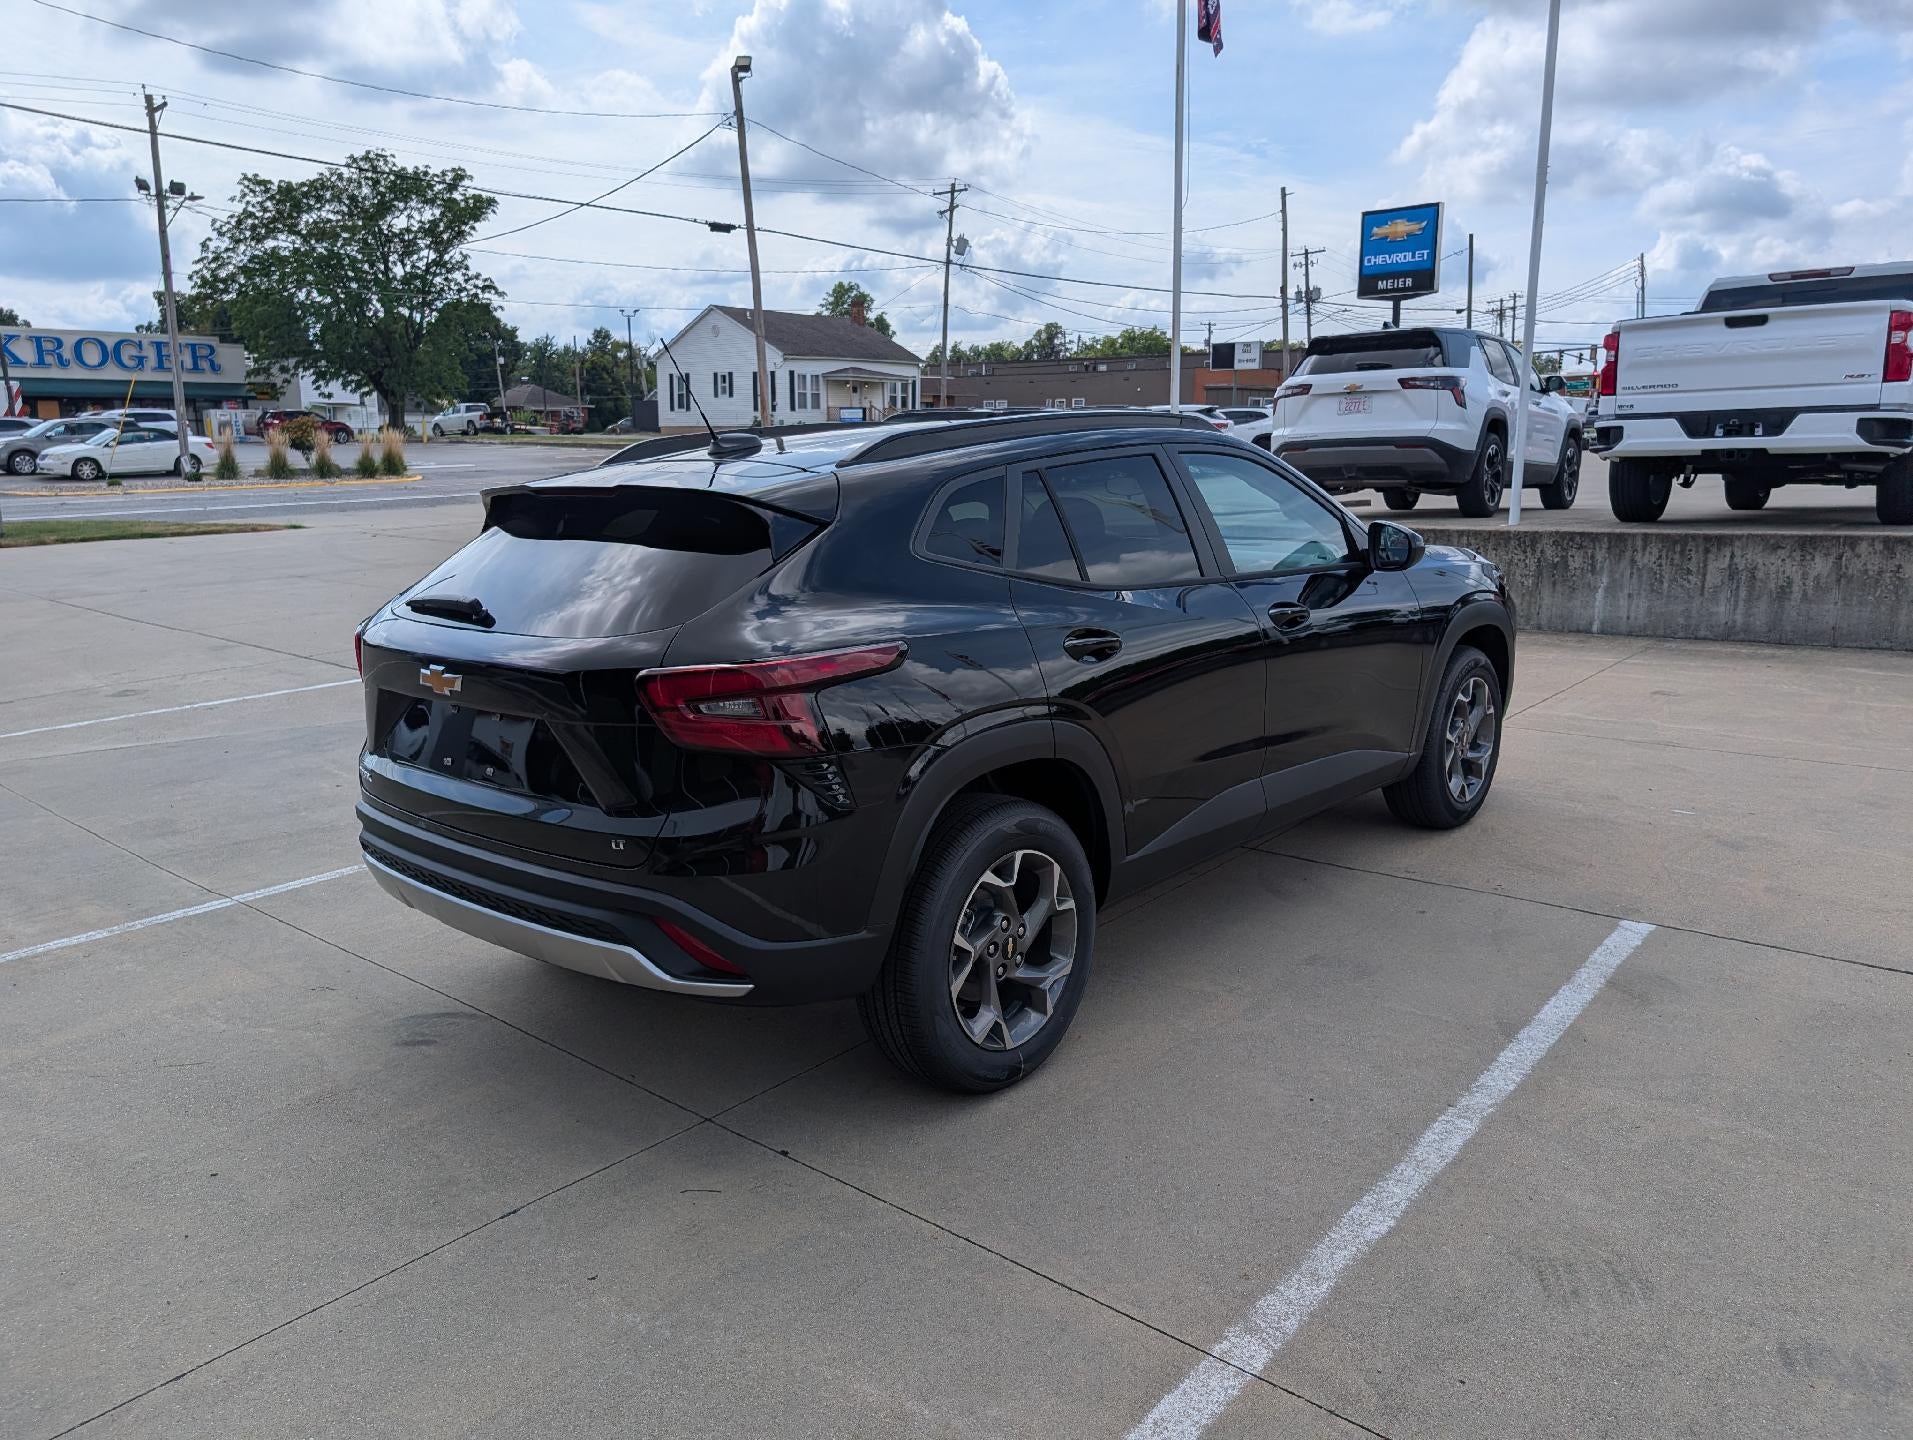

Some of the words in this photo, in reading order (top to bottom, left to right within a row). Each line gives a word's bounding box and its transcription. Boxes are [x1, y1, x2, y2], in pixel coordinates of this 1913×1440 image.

[1364, 249, 1429, 266] CHEVROLET
[1377, 277, 1412, 290] MEIER
[0, 334, 223, 373] KROGER
[1621, 383, 1679, 391] SILVERADO
[611, 839, 626, 850] LT
